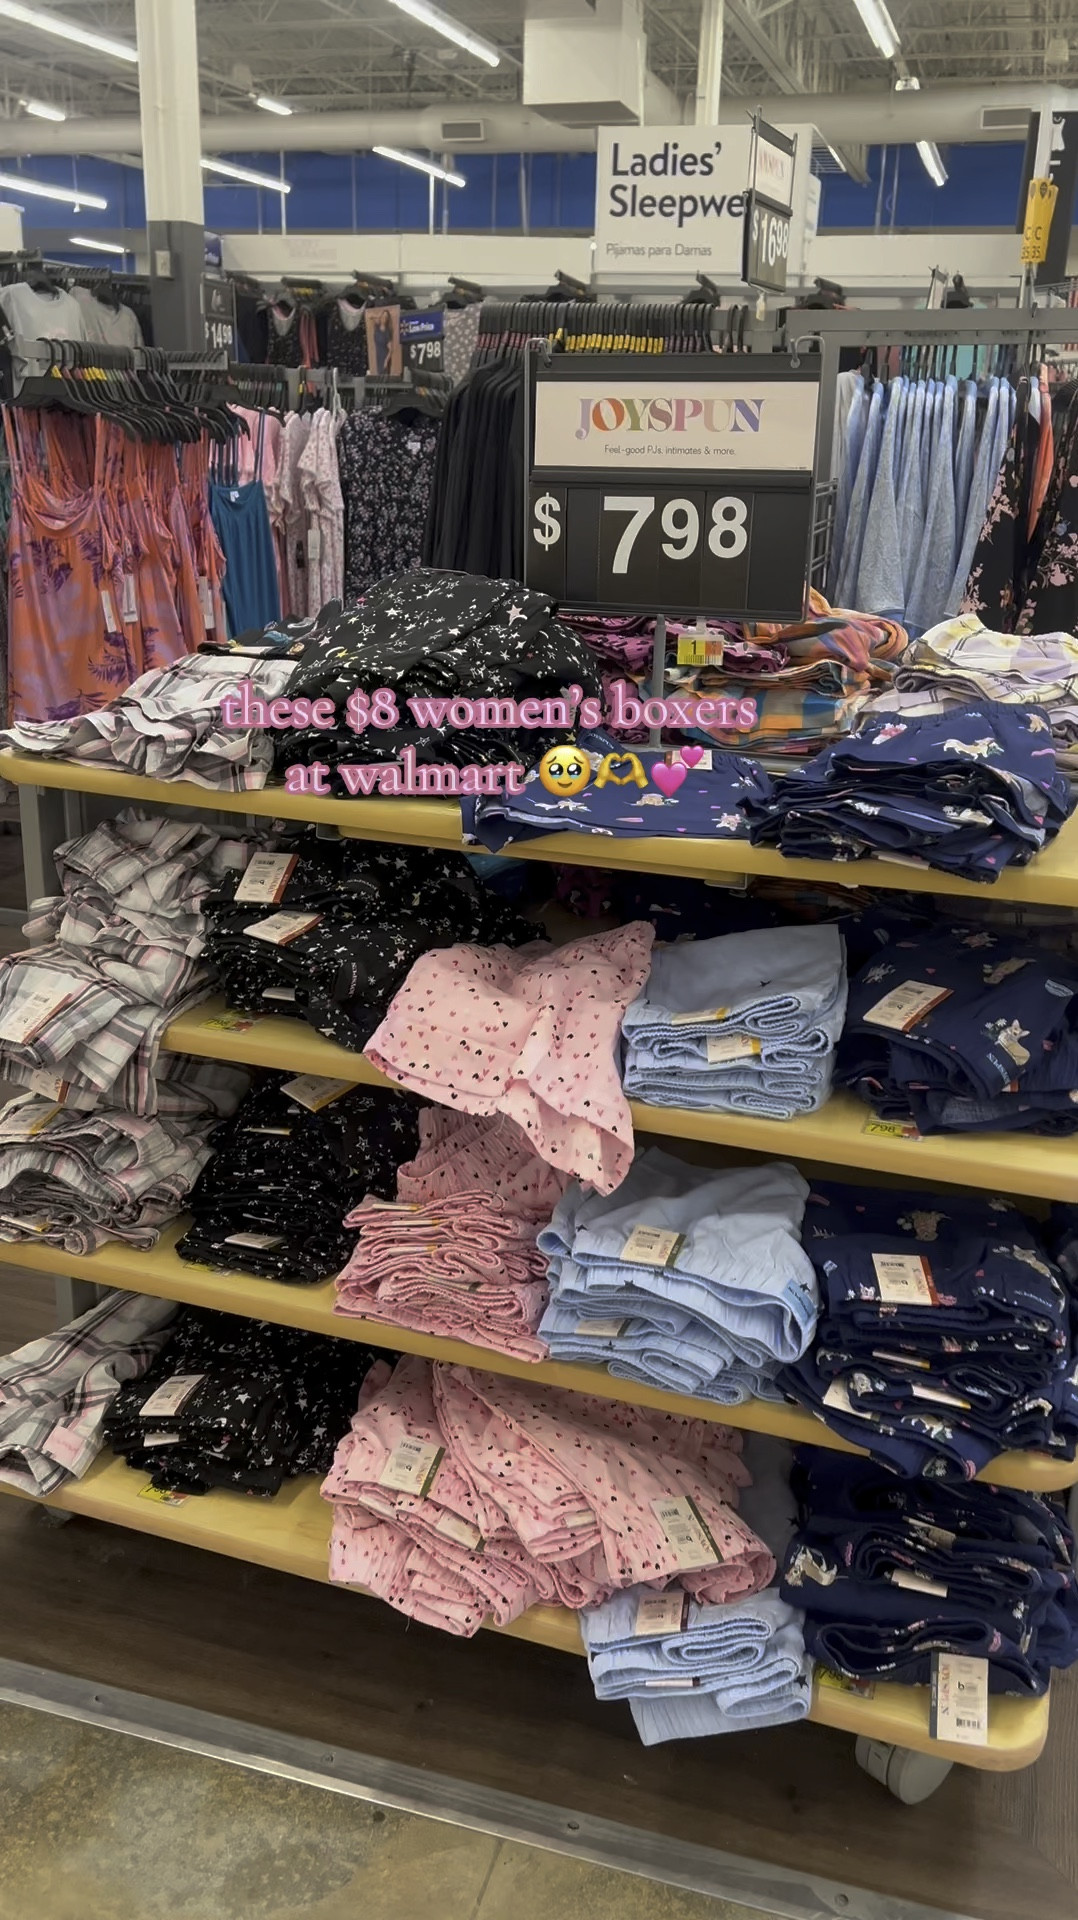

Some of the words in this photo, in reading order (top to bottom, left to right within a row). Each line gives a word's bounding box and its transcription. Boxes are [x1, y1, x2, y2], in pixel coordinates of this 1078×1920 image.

[612, 141, 721, 176] Ladies’
[606, 242, 646, 259] Pijamas
[648, 246, 672, 259] para
[674, 243, 712, 256] Damas
[575, 398, 766, 440] JOYSPUN
[604, 444, 646, 456] Feel-good
[665, 445, 702, 456] intimates
[704, 446, 711, 456] &
[533, 492, 561, 552] $
[603, 495, 748, 574] 798
